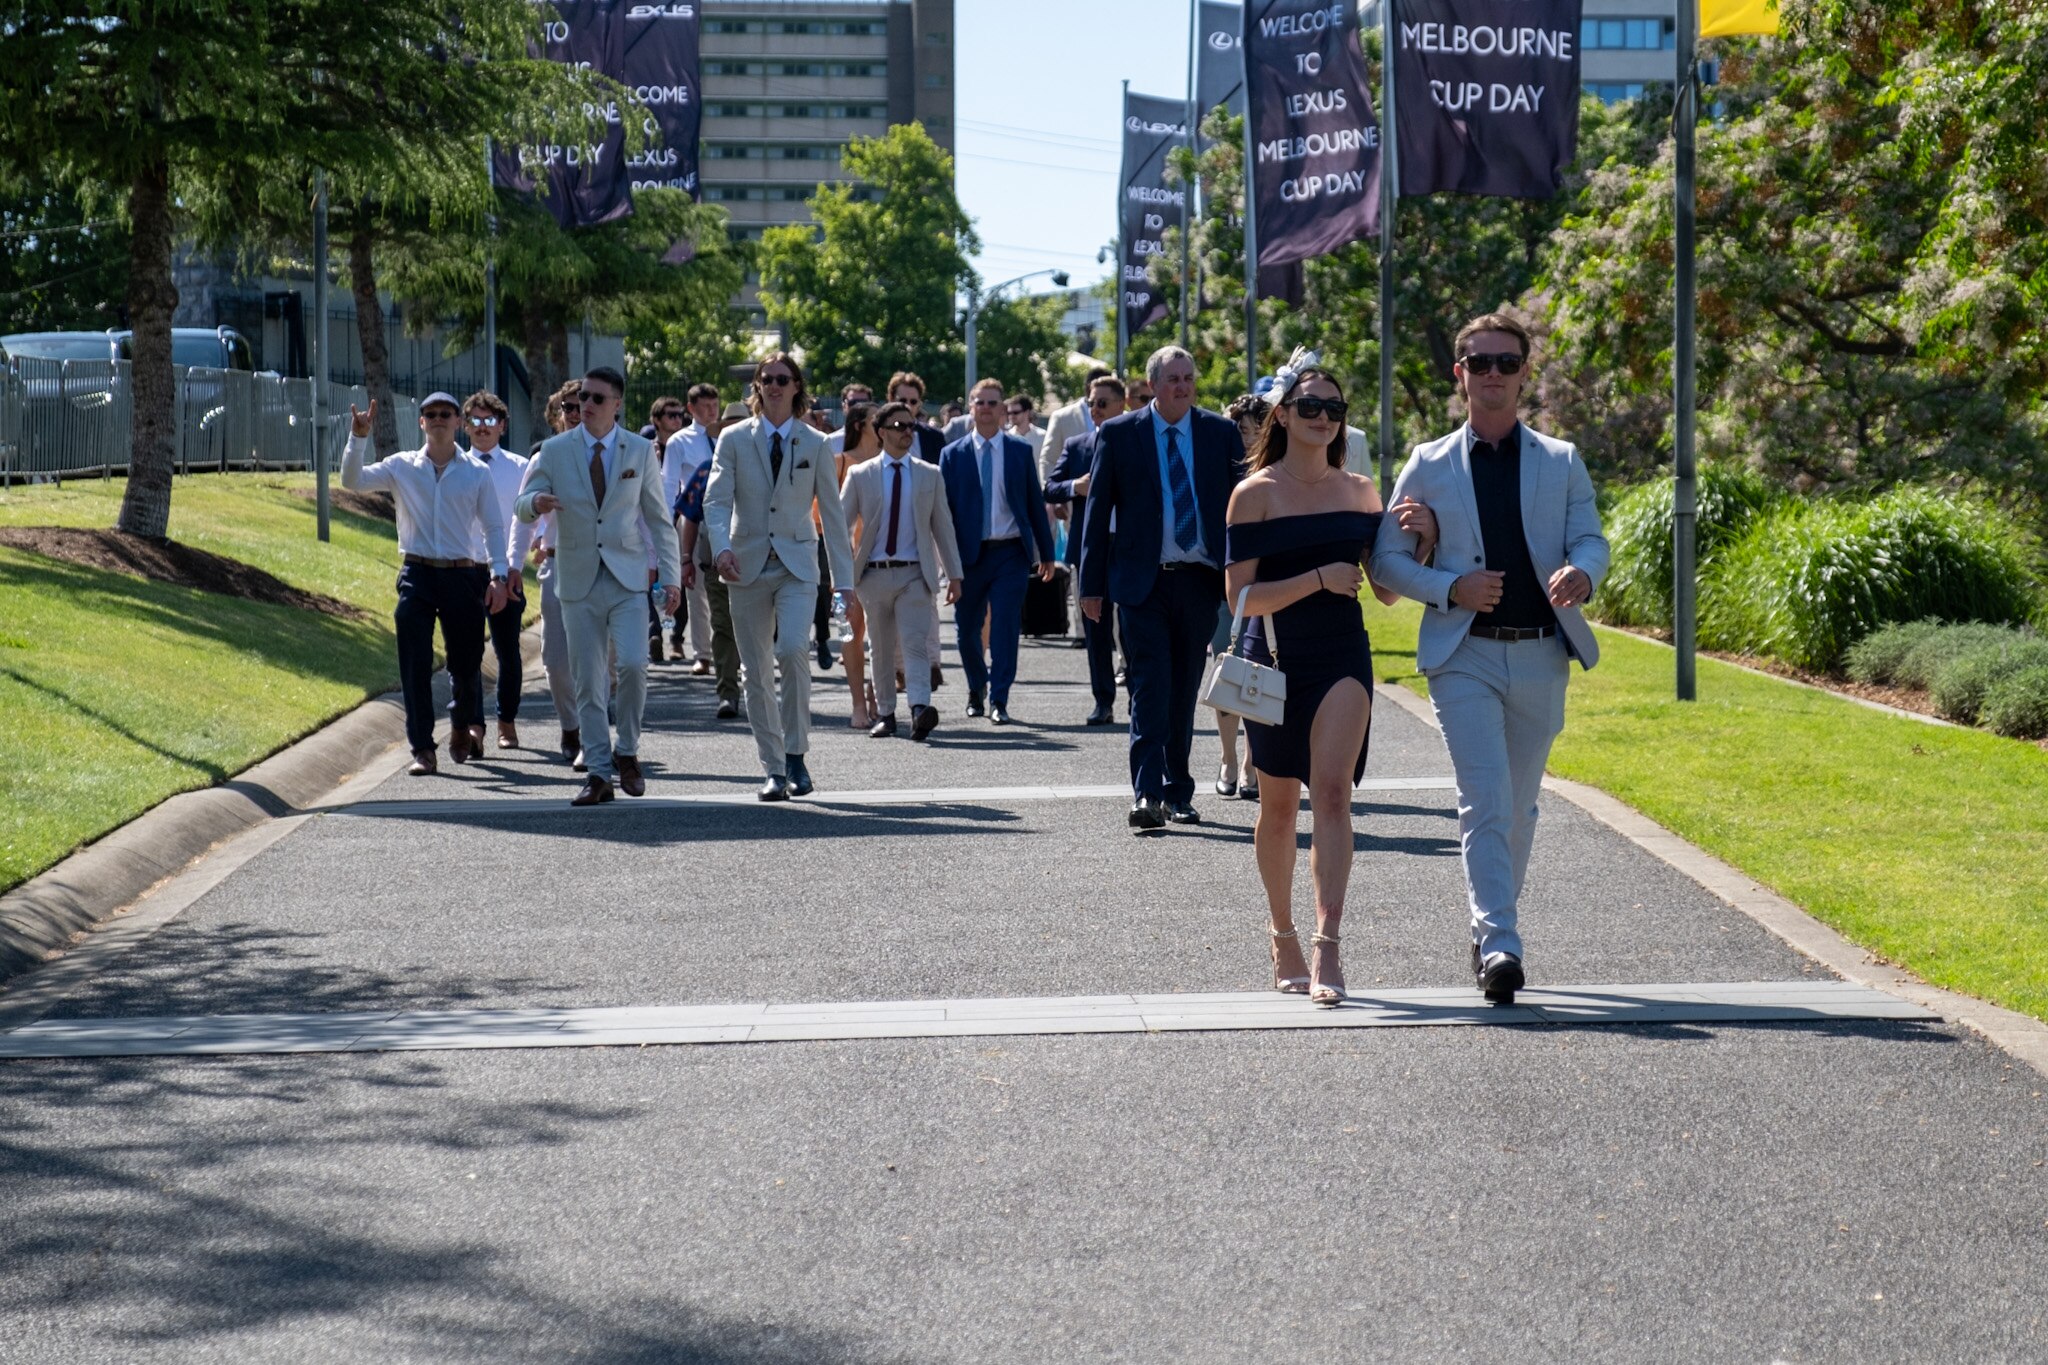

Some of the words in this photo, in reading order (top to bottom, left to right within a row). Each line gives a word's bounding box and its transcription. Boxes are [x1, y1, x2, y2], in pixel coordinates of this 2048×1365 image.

[544, 20, 569, 43] TO
[1260, 4, 1344, 39] WELCOME
[1400, 21, 1573, 62] MELBOURNE
[1295, 52, 1322, 76] TO
[1286, 88, 1347, 118] LEXUS
[1429, 79, 1484, 113] CUP
[1489, 83, 1546, 114] DAY
[1258, 125, 1379, 164] MELBOURNE
[1127, 186, 1185, 205] WELCOME
[1280, 176, 1322, 202] CUP
[1325, 169, 1366, 195] DAY
[1144, 213, 1164, 231] TO
